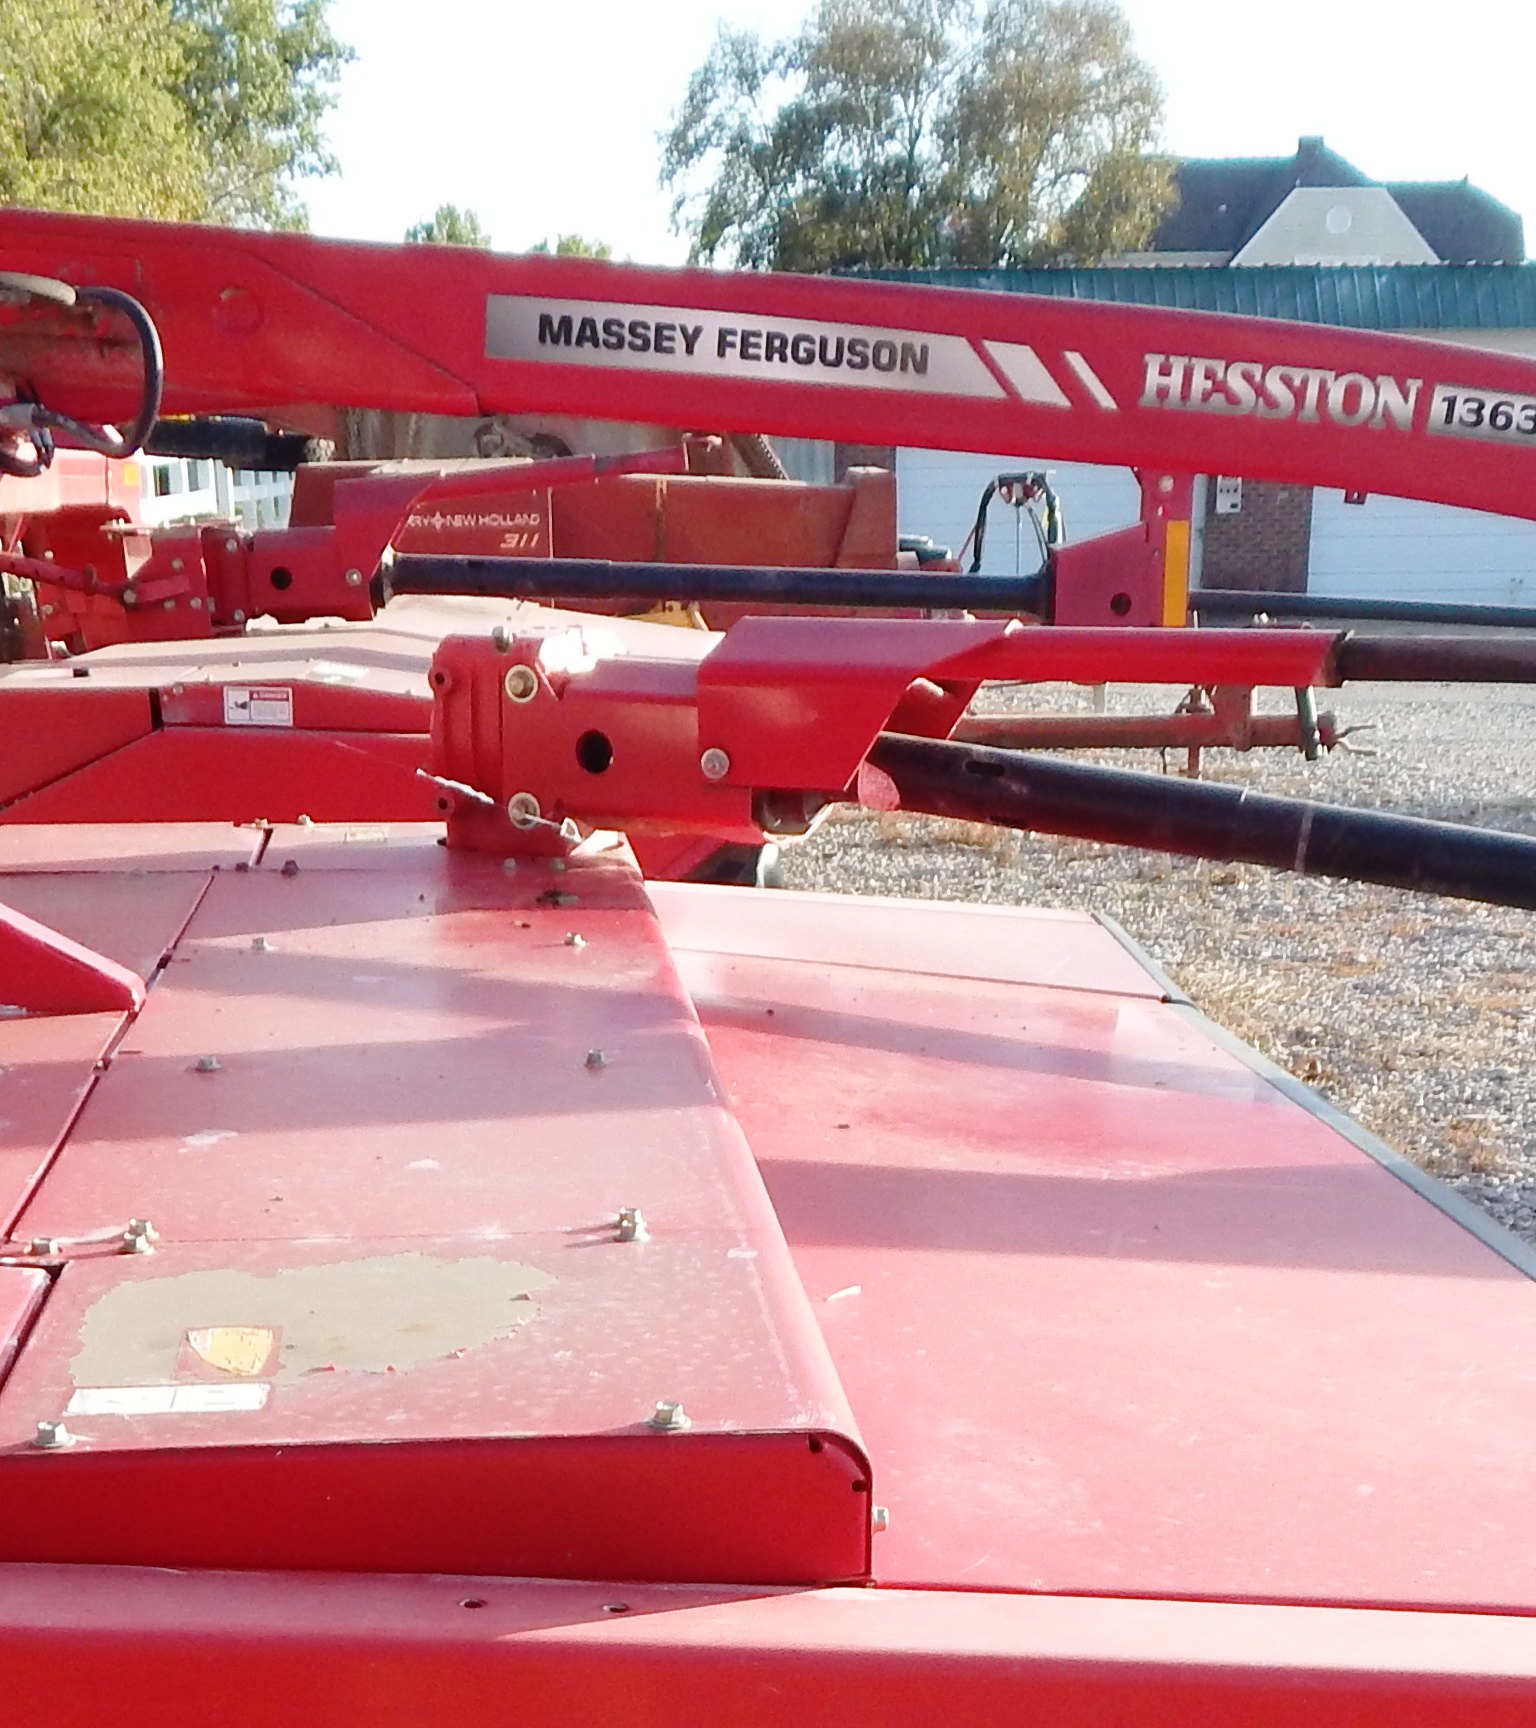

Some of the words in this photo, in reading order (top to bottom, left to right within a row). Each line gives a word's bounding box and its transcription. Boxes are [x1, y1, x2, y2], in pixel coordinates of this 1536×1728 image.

[538, 313, 703, 356] MASSEY
[716, 326, 930, 375] FERGUSON
[1139, 352, 1423, 431] HESSTON
[446, 514, 477, 527] NEW
[479, 513, 541, 526] HOLLAND
[500, 533, 539, 548] 311
